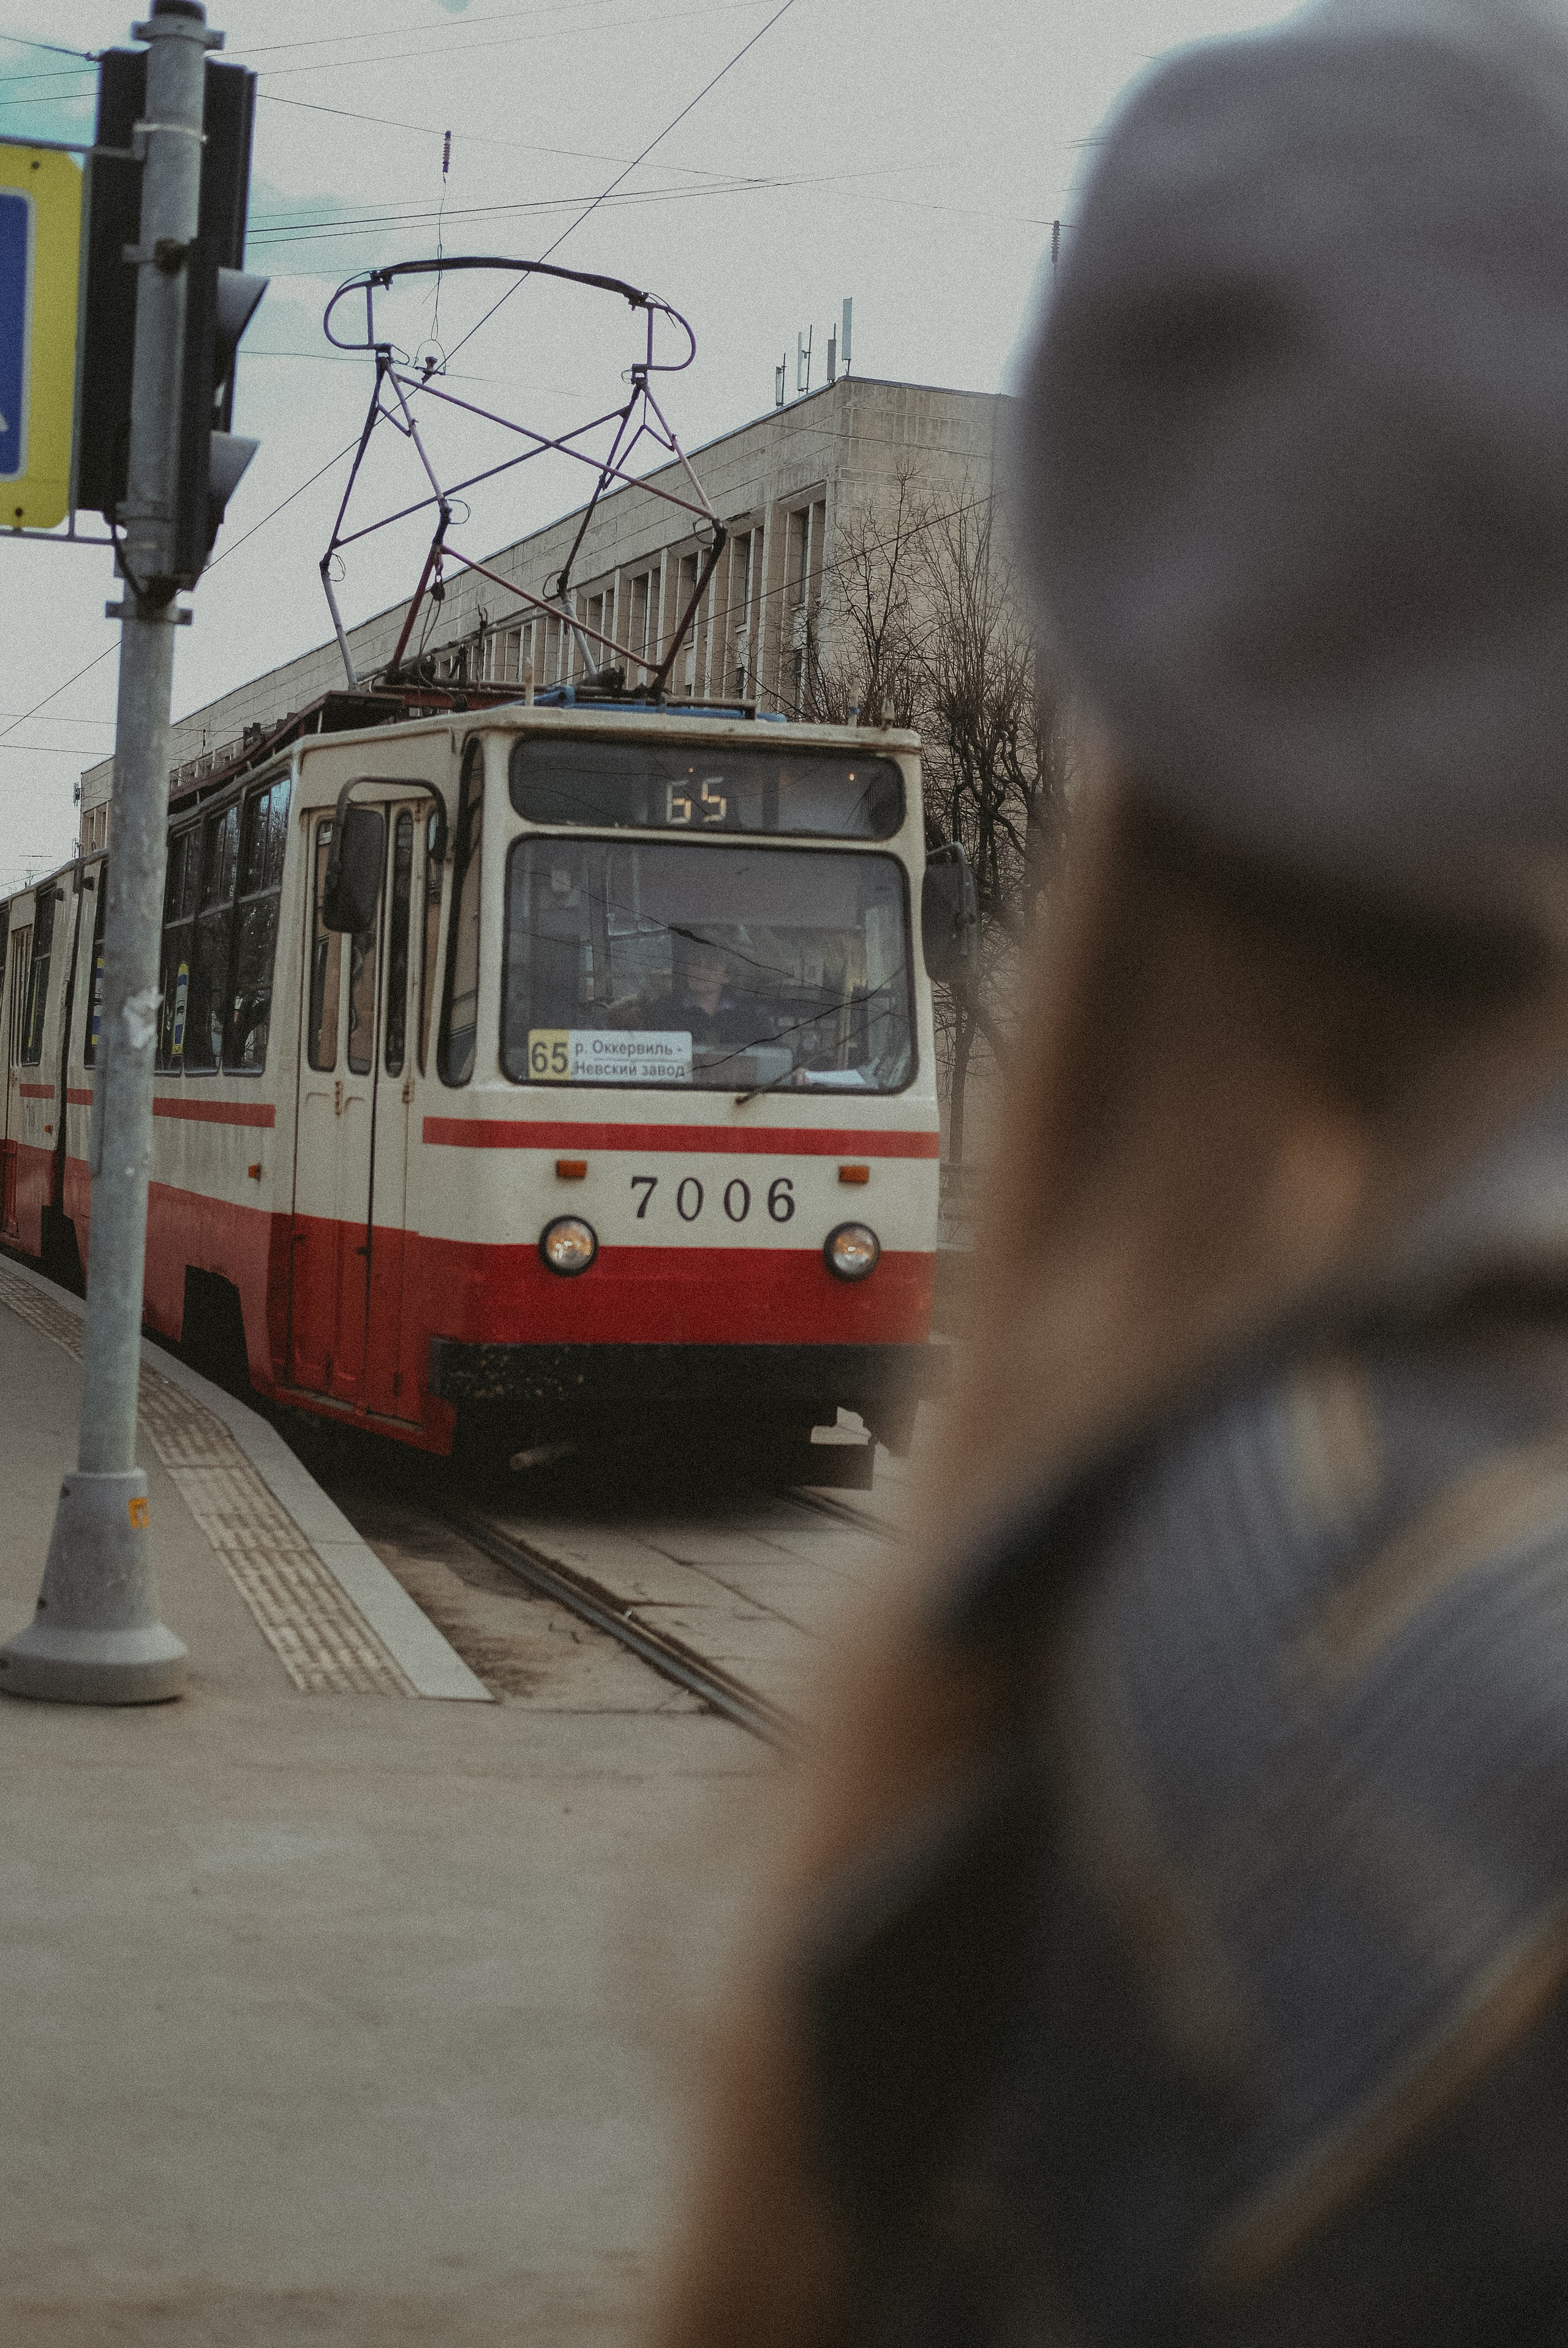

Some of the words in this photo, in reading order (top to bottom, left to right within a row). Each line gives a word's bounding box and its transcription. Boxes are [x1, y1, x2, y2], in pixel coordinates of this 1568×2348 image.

[666, 777, 726, 824] 65
[531, 1042, 568, 1073] 65
[575, 1043, 587, 1055] р.
[593, 1040, 673, 1058] Оккервиль
[575, 1062, 637, 1075] Невский
[643, 1065, 685, 1078] завод
[631, 1176, 795, 1222] 7006
